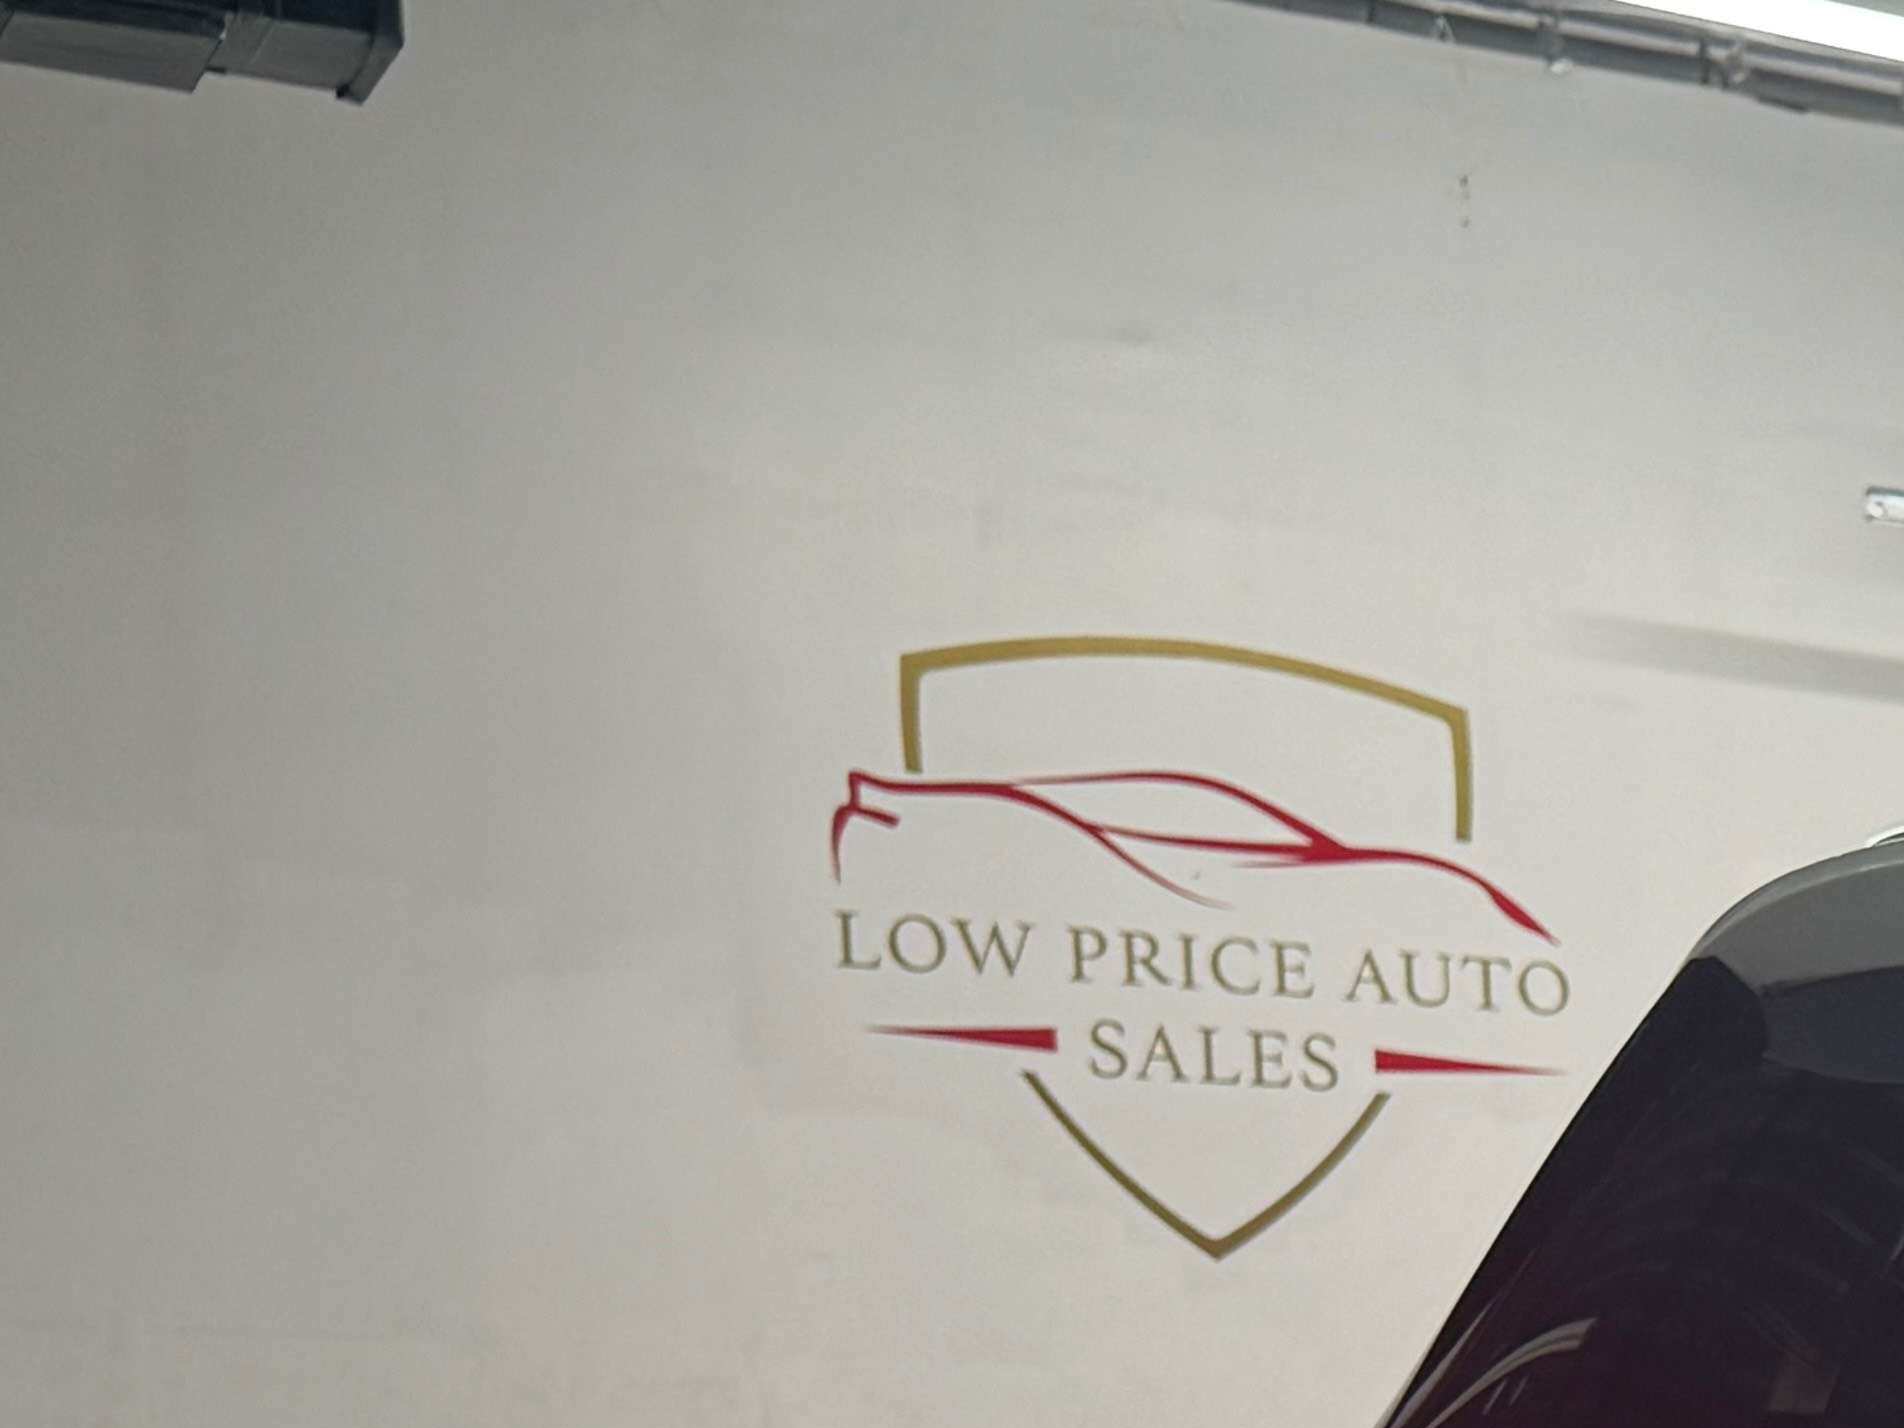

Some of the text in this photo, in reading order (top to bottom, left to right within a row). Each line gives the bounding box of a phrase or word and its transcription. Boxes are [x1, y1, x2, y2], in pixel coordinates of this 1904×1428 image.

[834, 910, 1573, 1017] LOW PRICE AUTO
[1087, 1018, 1341, 1092] SALES
